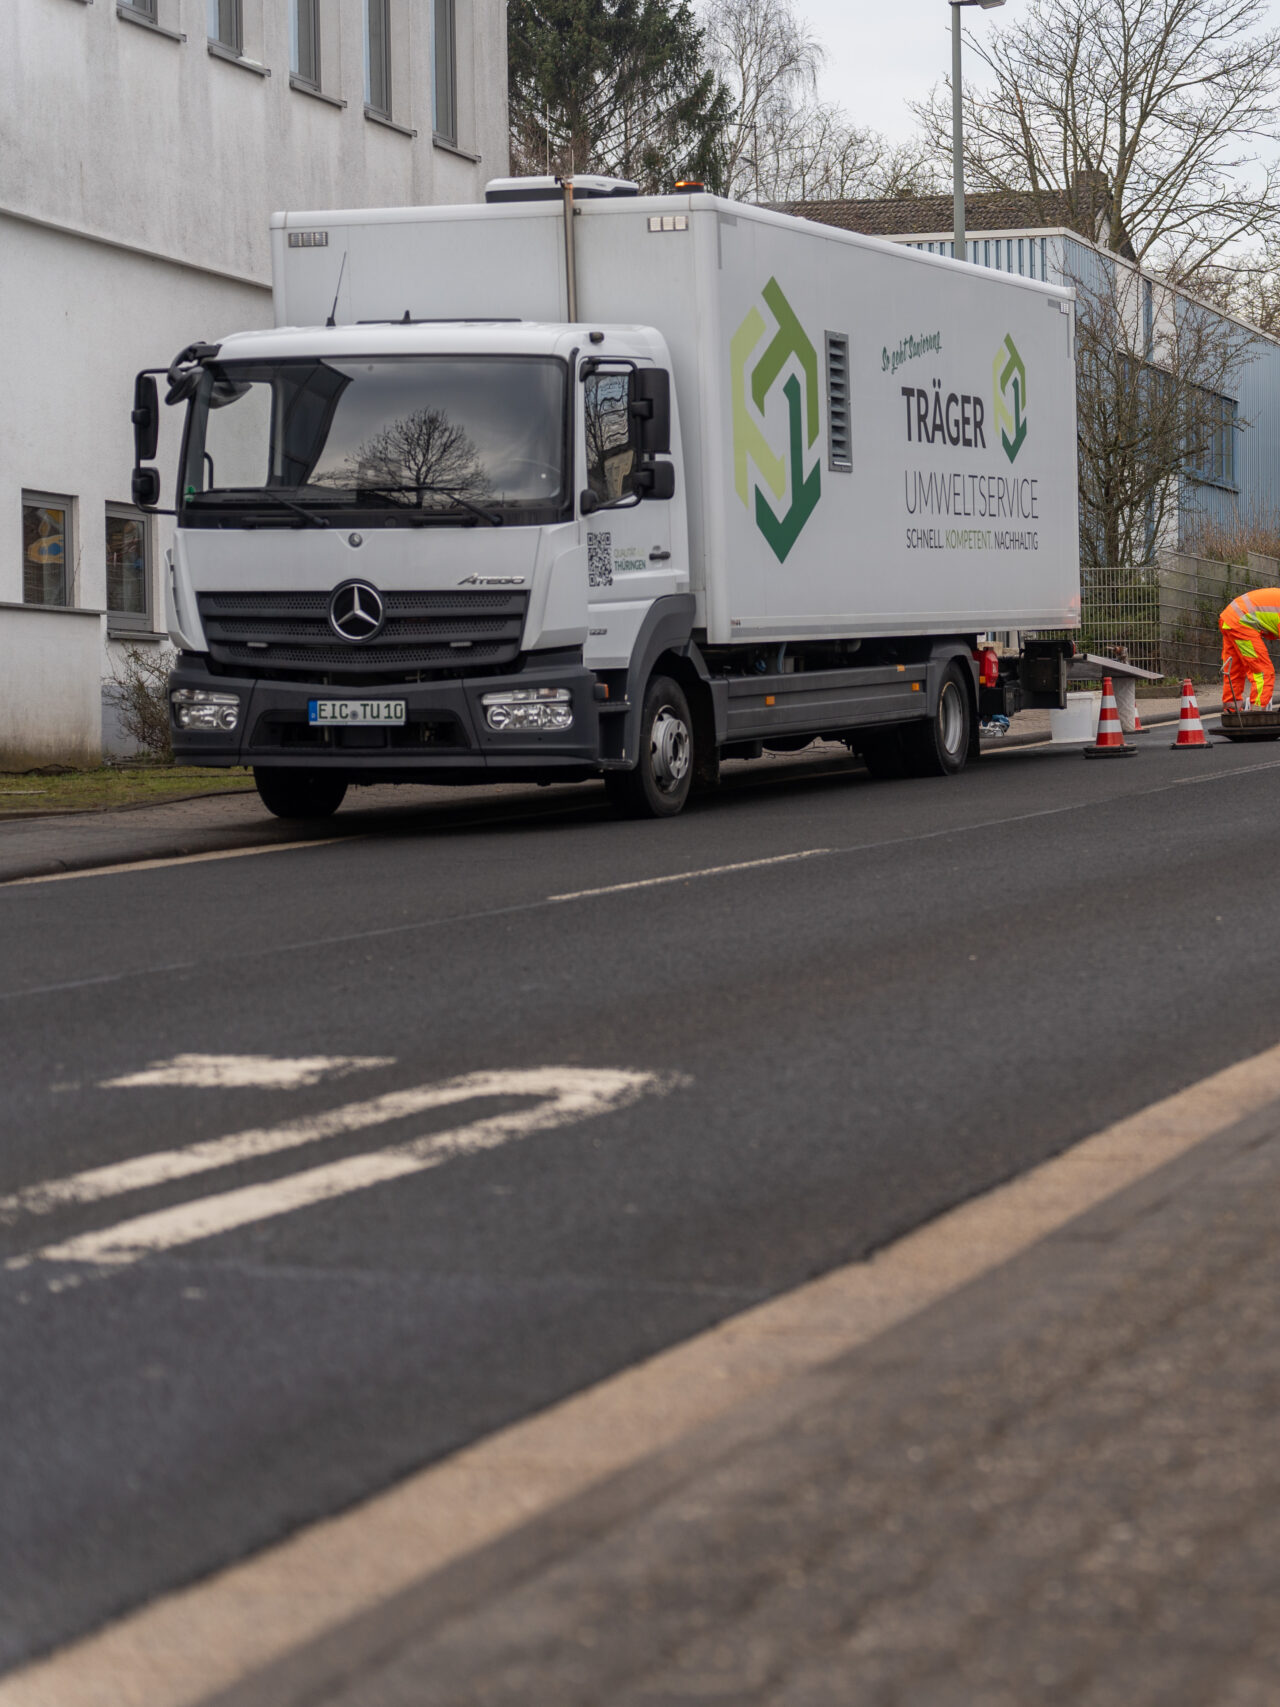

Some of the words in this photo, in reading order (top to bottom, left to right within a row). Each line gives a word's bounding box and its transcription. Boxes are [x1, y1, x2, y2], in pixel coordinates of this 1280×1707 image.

[891, 338, 908, 375] geht
[908, 330, 942, 359] Sanierung
[901, 378, 986, 449] TRÄGER
[905, 470, 1039, 519] UMWELTSERVICE
[906, 528, 944, 549] SCHNELL.
[994, 530, 1039, 551] NACHHALTIG
[613, 558, 647, 571] THÜRINGEN
[319, 703, 349, 719] EIC
